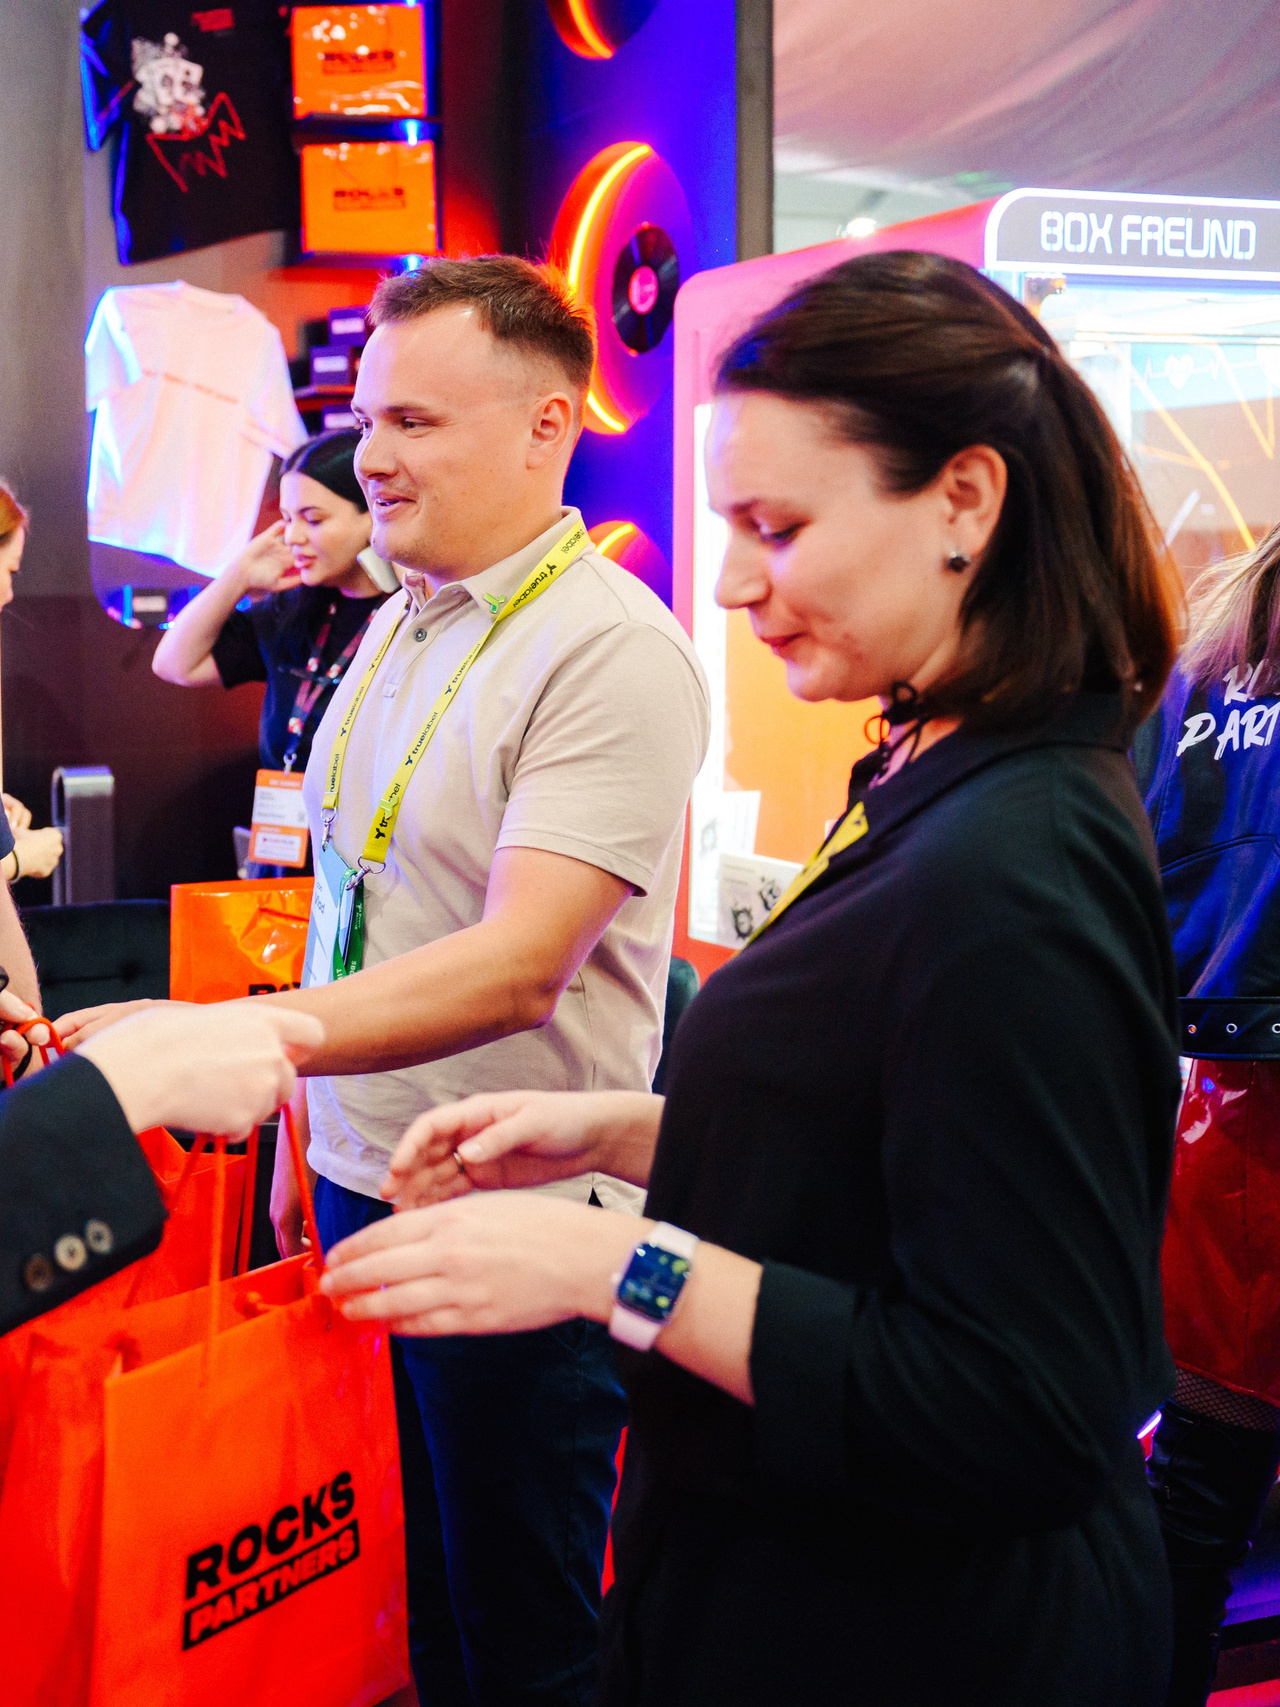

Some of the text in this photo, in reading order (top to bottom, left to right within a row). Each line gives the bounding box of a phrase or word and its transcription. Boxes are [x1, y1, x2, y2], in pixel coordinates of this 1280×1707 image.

[1040, 210, 1114, 254] BOX
[412, 711, 438, 755] truelabel
[330, 753, 340, 793] ruelabel
[185, 1470, 355, 1600] ROCKS
[188, 1527, 356, 1643] PARTNERS
